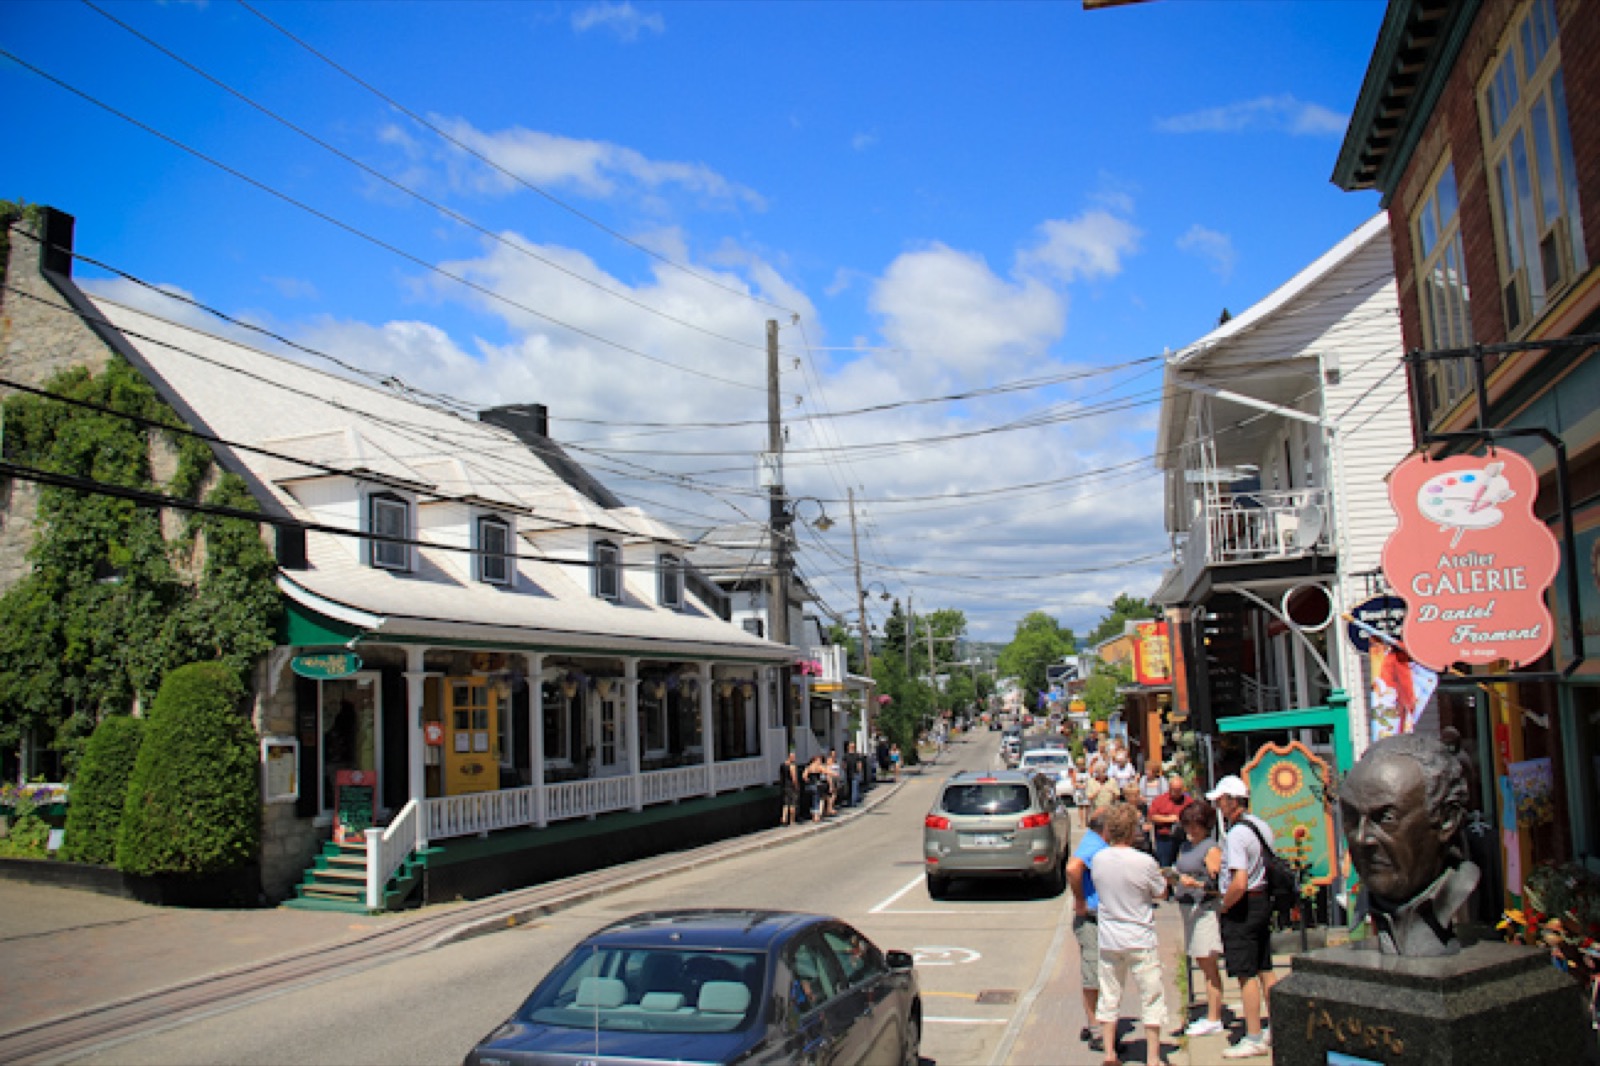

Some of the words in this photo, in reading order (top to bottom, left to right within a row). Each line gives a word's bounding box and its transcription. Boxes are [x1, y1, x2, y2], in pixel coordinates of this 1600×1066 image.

[1436, 552, 1495, 570] Atelier
[1411, 566, 1528, 597] GALERIE
[1416, 598, 1496, 623] Daniel
[1449, 623, 1542, 645] Froment
